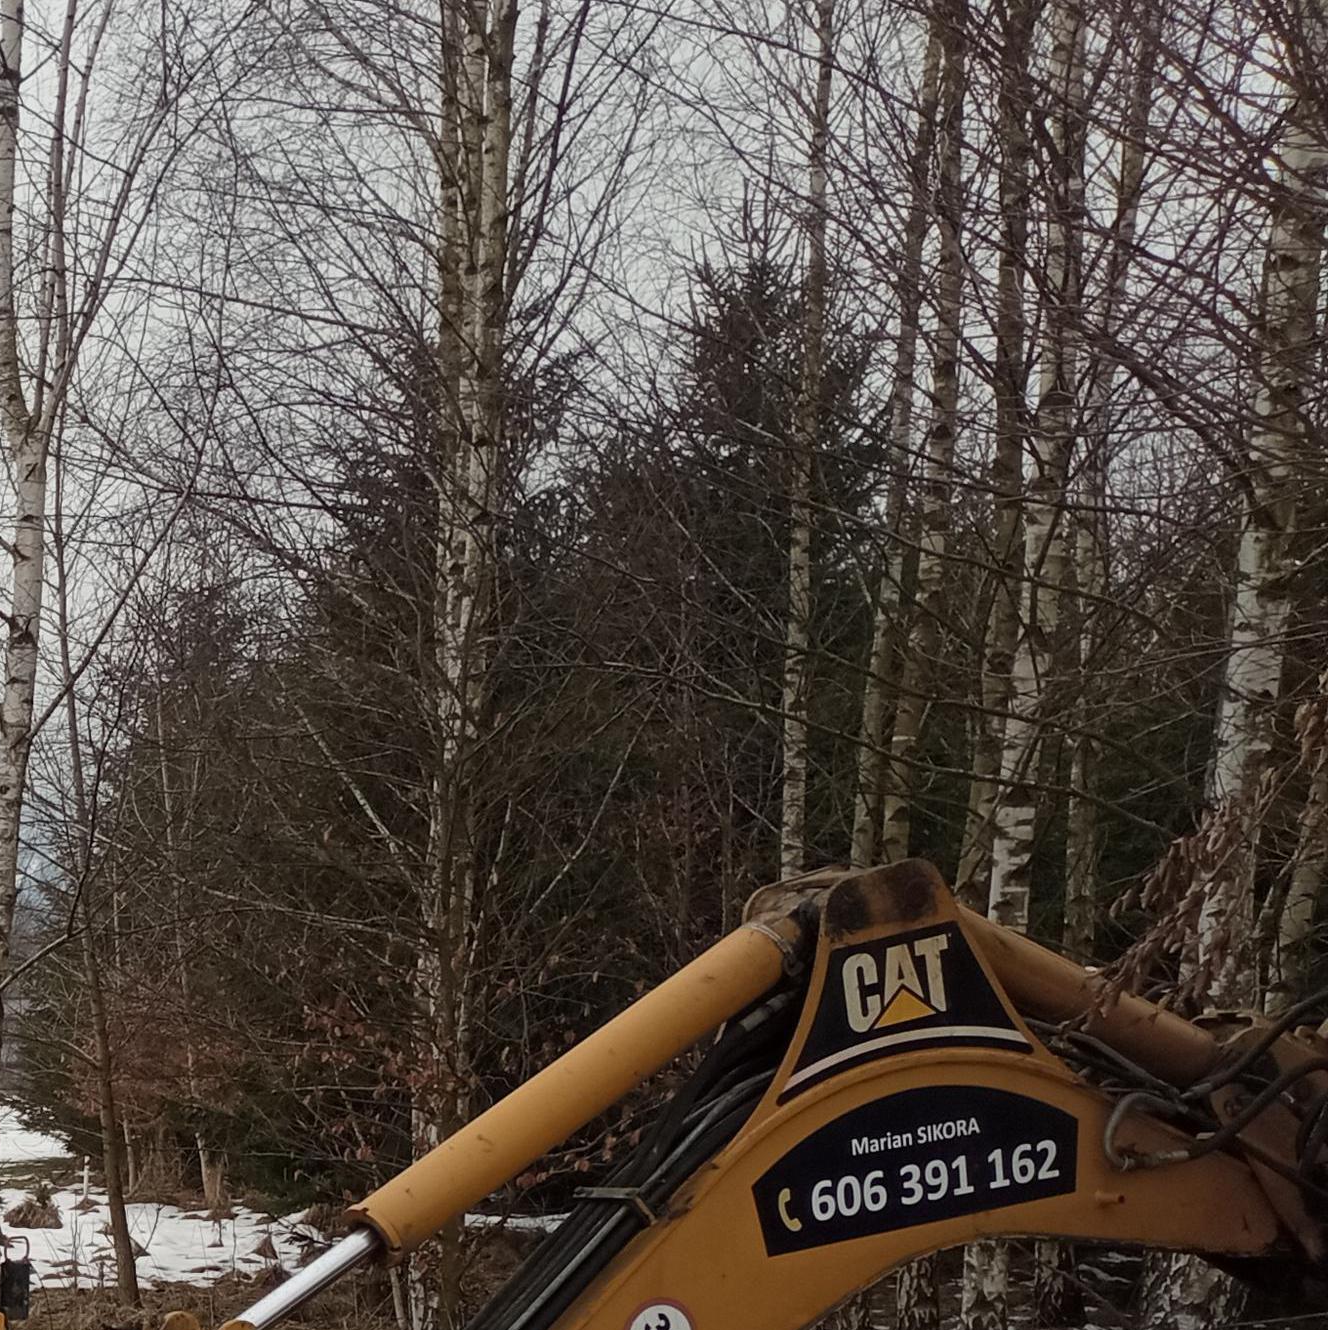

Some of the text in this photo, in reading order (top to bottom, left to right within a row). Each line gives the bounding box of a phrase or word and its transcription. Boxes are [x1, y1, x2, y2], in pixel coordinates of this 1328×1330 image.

[842, 933, 948, 1033] CAT
[851, 1117, 980, 1156] Marian SIKORA
[811, 1139, 1060, 1222] 606 391 162
